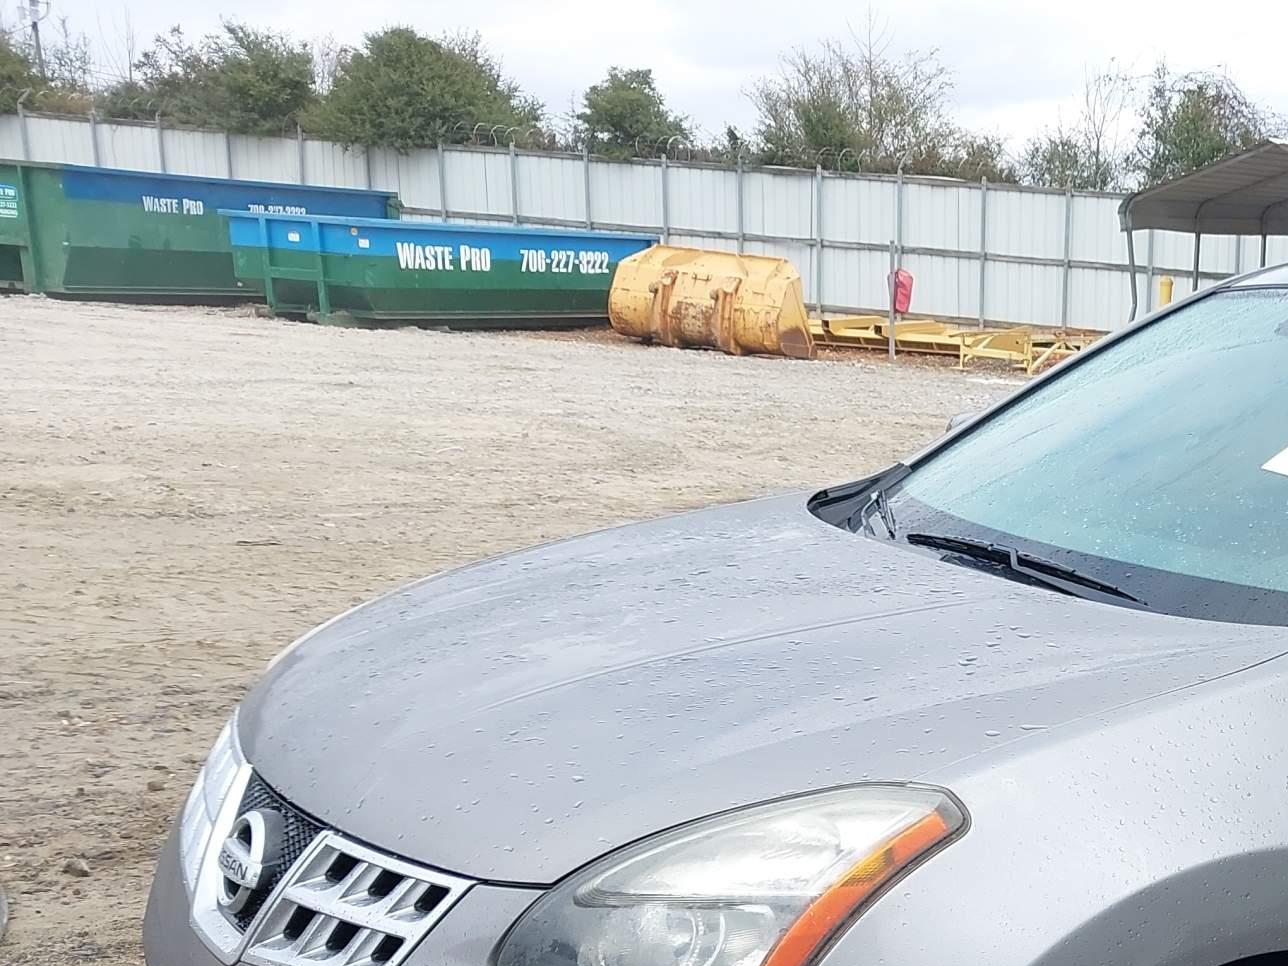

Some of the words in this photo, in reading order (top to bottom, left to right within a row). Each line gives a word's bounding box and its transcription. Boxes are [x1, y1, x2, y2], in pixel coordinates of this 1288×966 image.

[142, 195, 179, 214] WASTE
[183, 198, 204, 216] PRO
[396, 242, 454, 271] WASTE
[459, 244, 491, 272] PRO
[519, 249, 610, 275] 706-227-3222
[219, 849, 249, 881] SSAN
